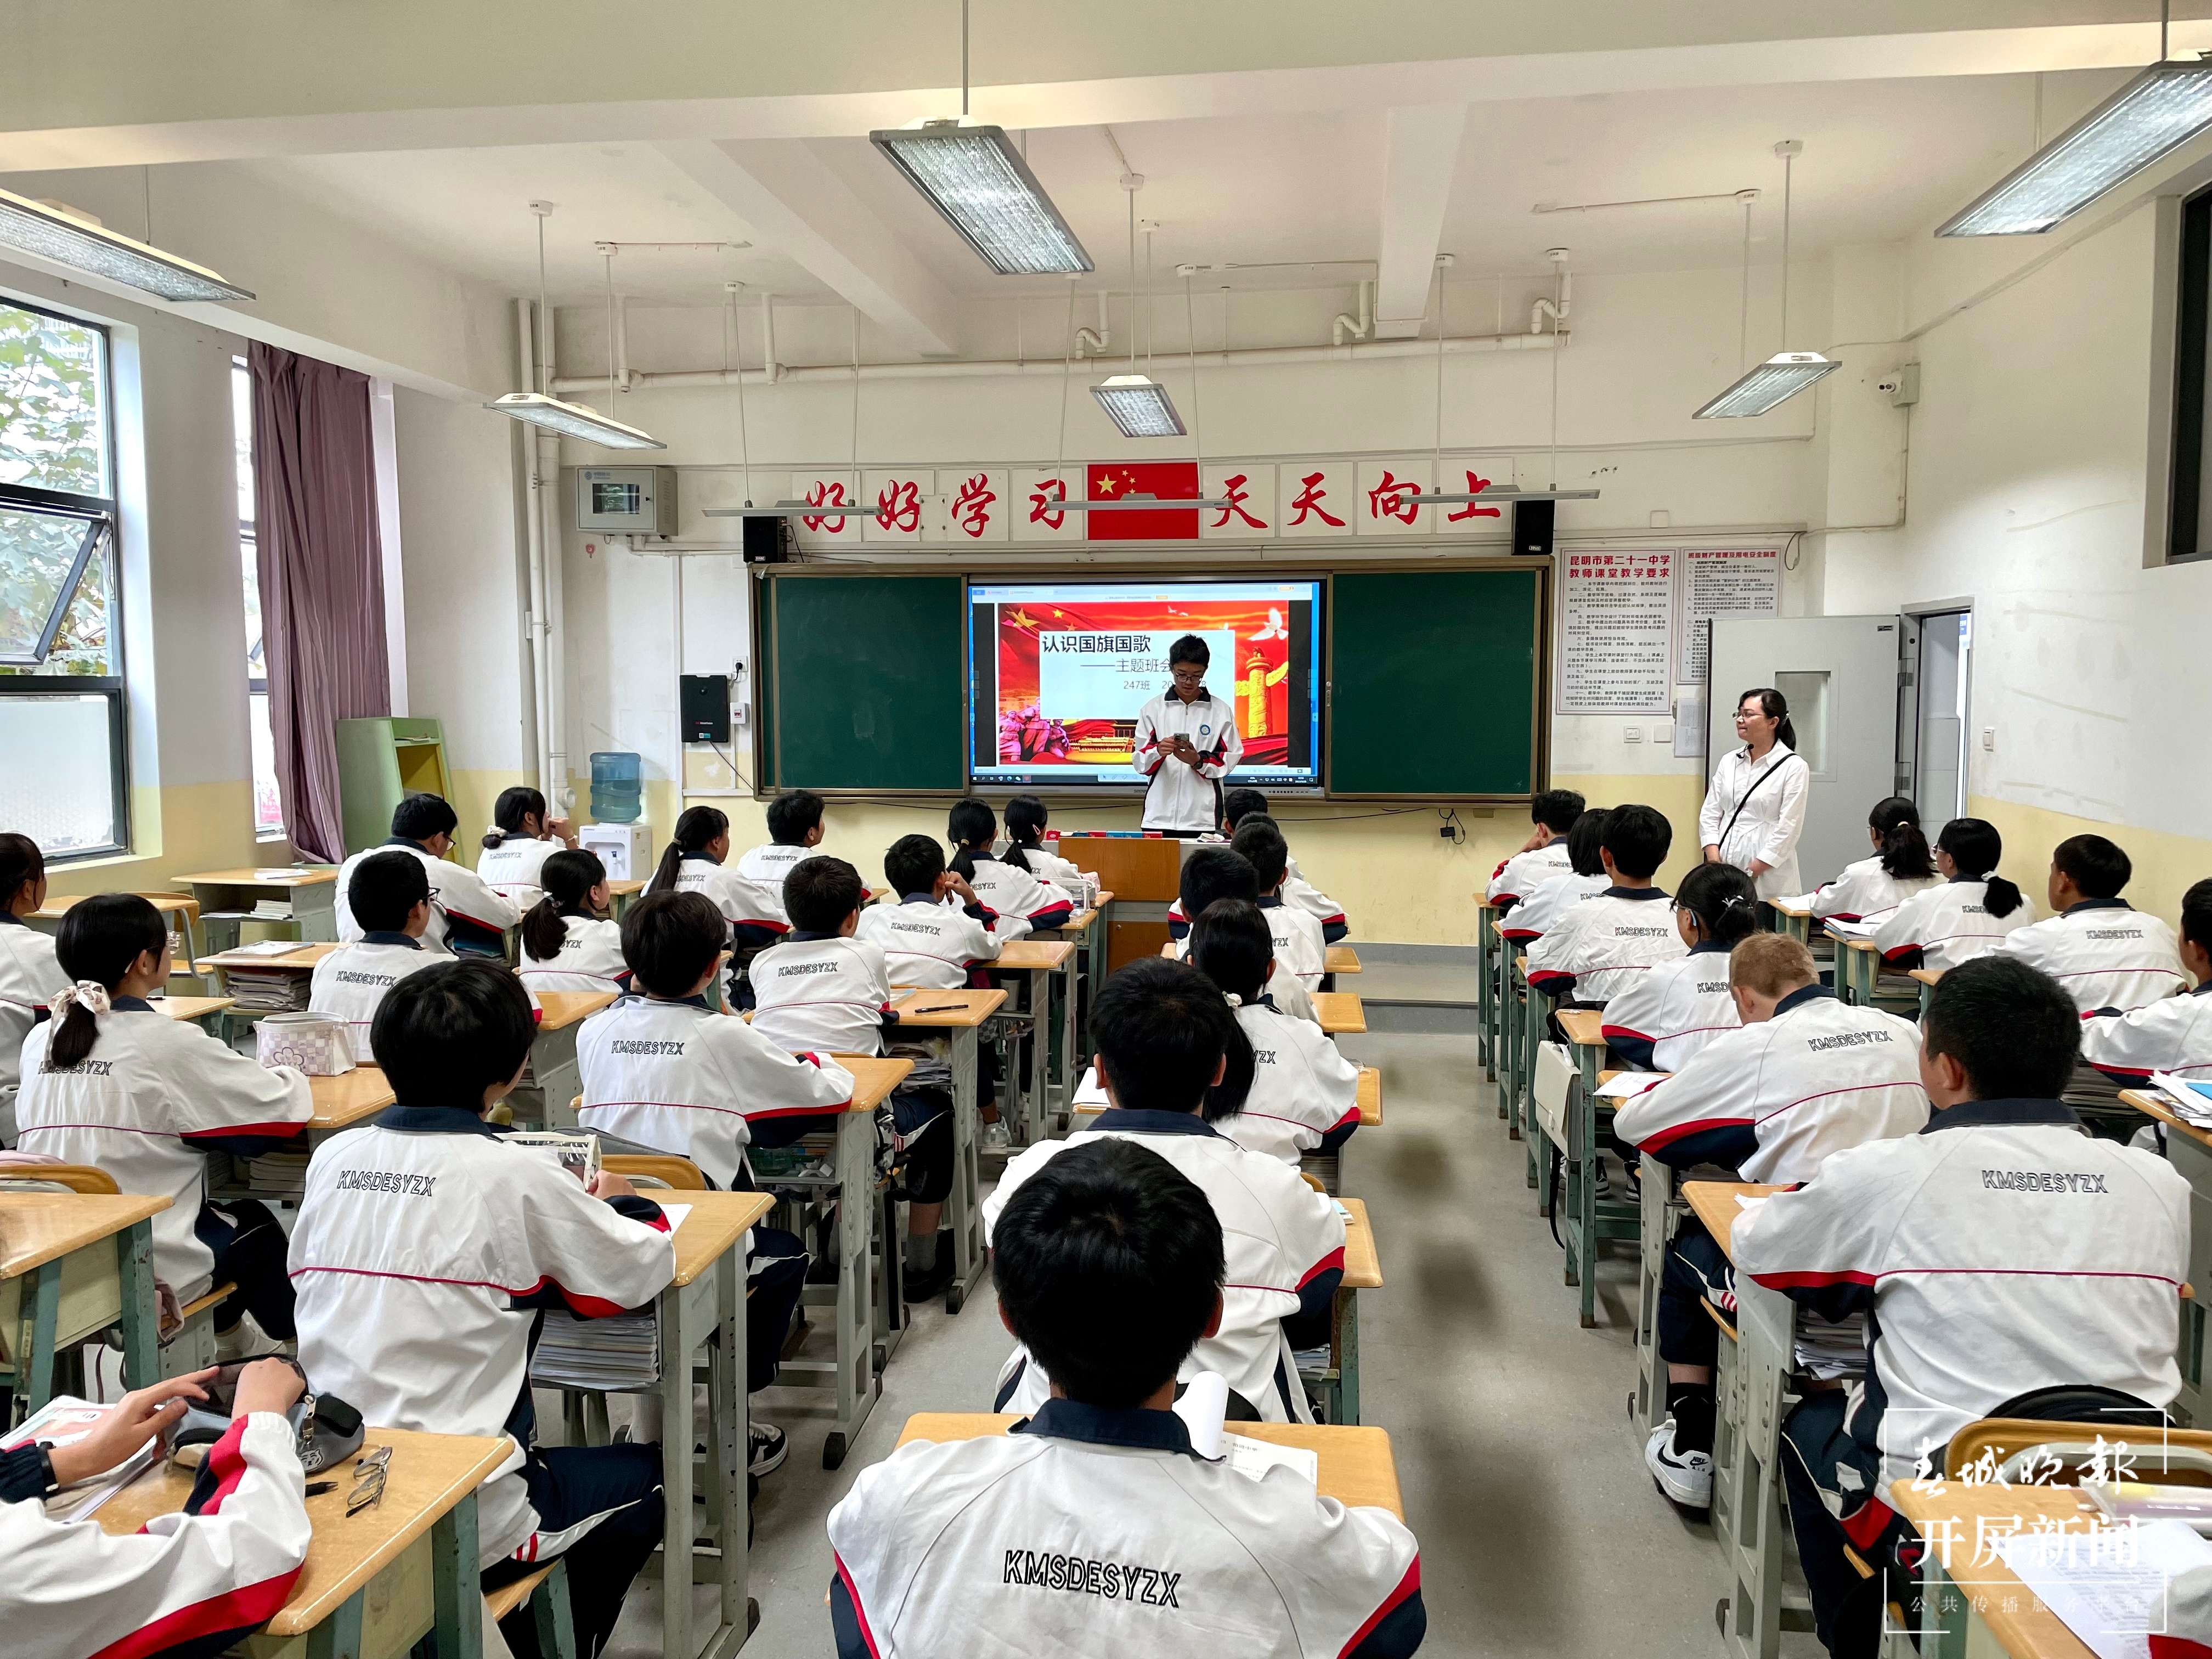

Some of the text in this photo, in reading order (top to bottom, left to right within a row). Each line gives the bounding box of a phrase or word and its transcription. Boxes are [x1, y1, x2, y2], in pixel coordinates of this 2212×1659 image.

[803, 470, 1500, 538] 好好学习 天天向上
[1570, 555, 1670, 565] 昆明市第二十一中学
[1569, 568, 1669, 578] 教师课堂教学要求
[1042, 635, 1151, 653] 认识国旗国歌
[1124, 680, 1150, 690] 247班
[891, 922, 940, 935] KMSDESYZX
[1615, 927, 1668, 937] KMSDESYZX
[778, 962, 838, 977] KMSDESYZX
[336, 970, 396, 987] KMSDESYZX
[611, 1040, 685, 1055] KMSDESYZX
[1808, 1031, 1893, 1051] KMSDESYZX
[337, 1170, 436, 1197] KMSDESYZX
[1982, 1170, 2109, 1193] KMSDESYZX
[1003, 1550, 1182, 1609] KMSDESYZX
